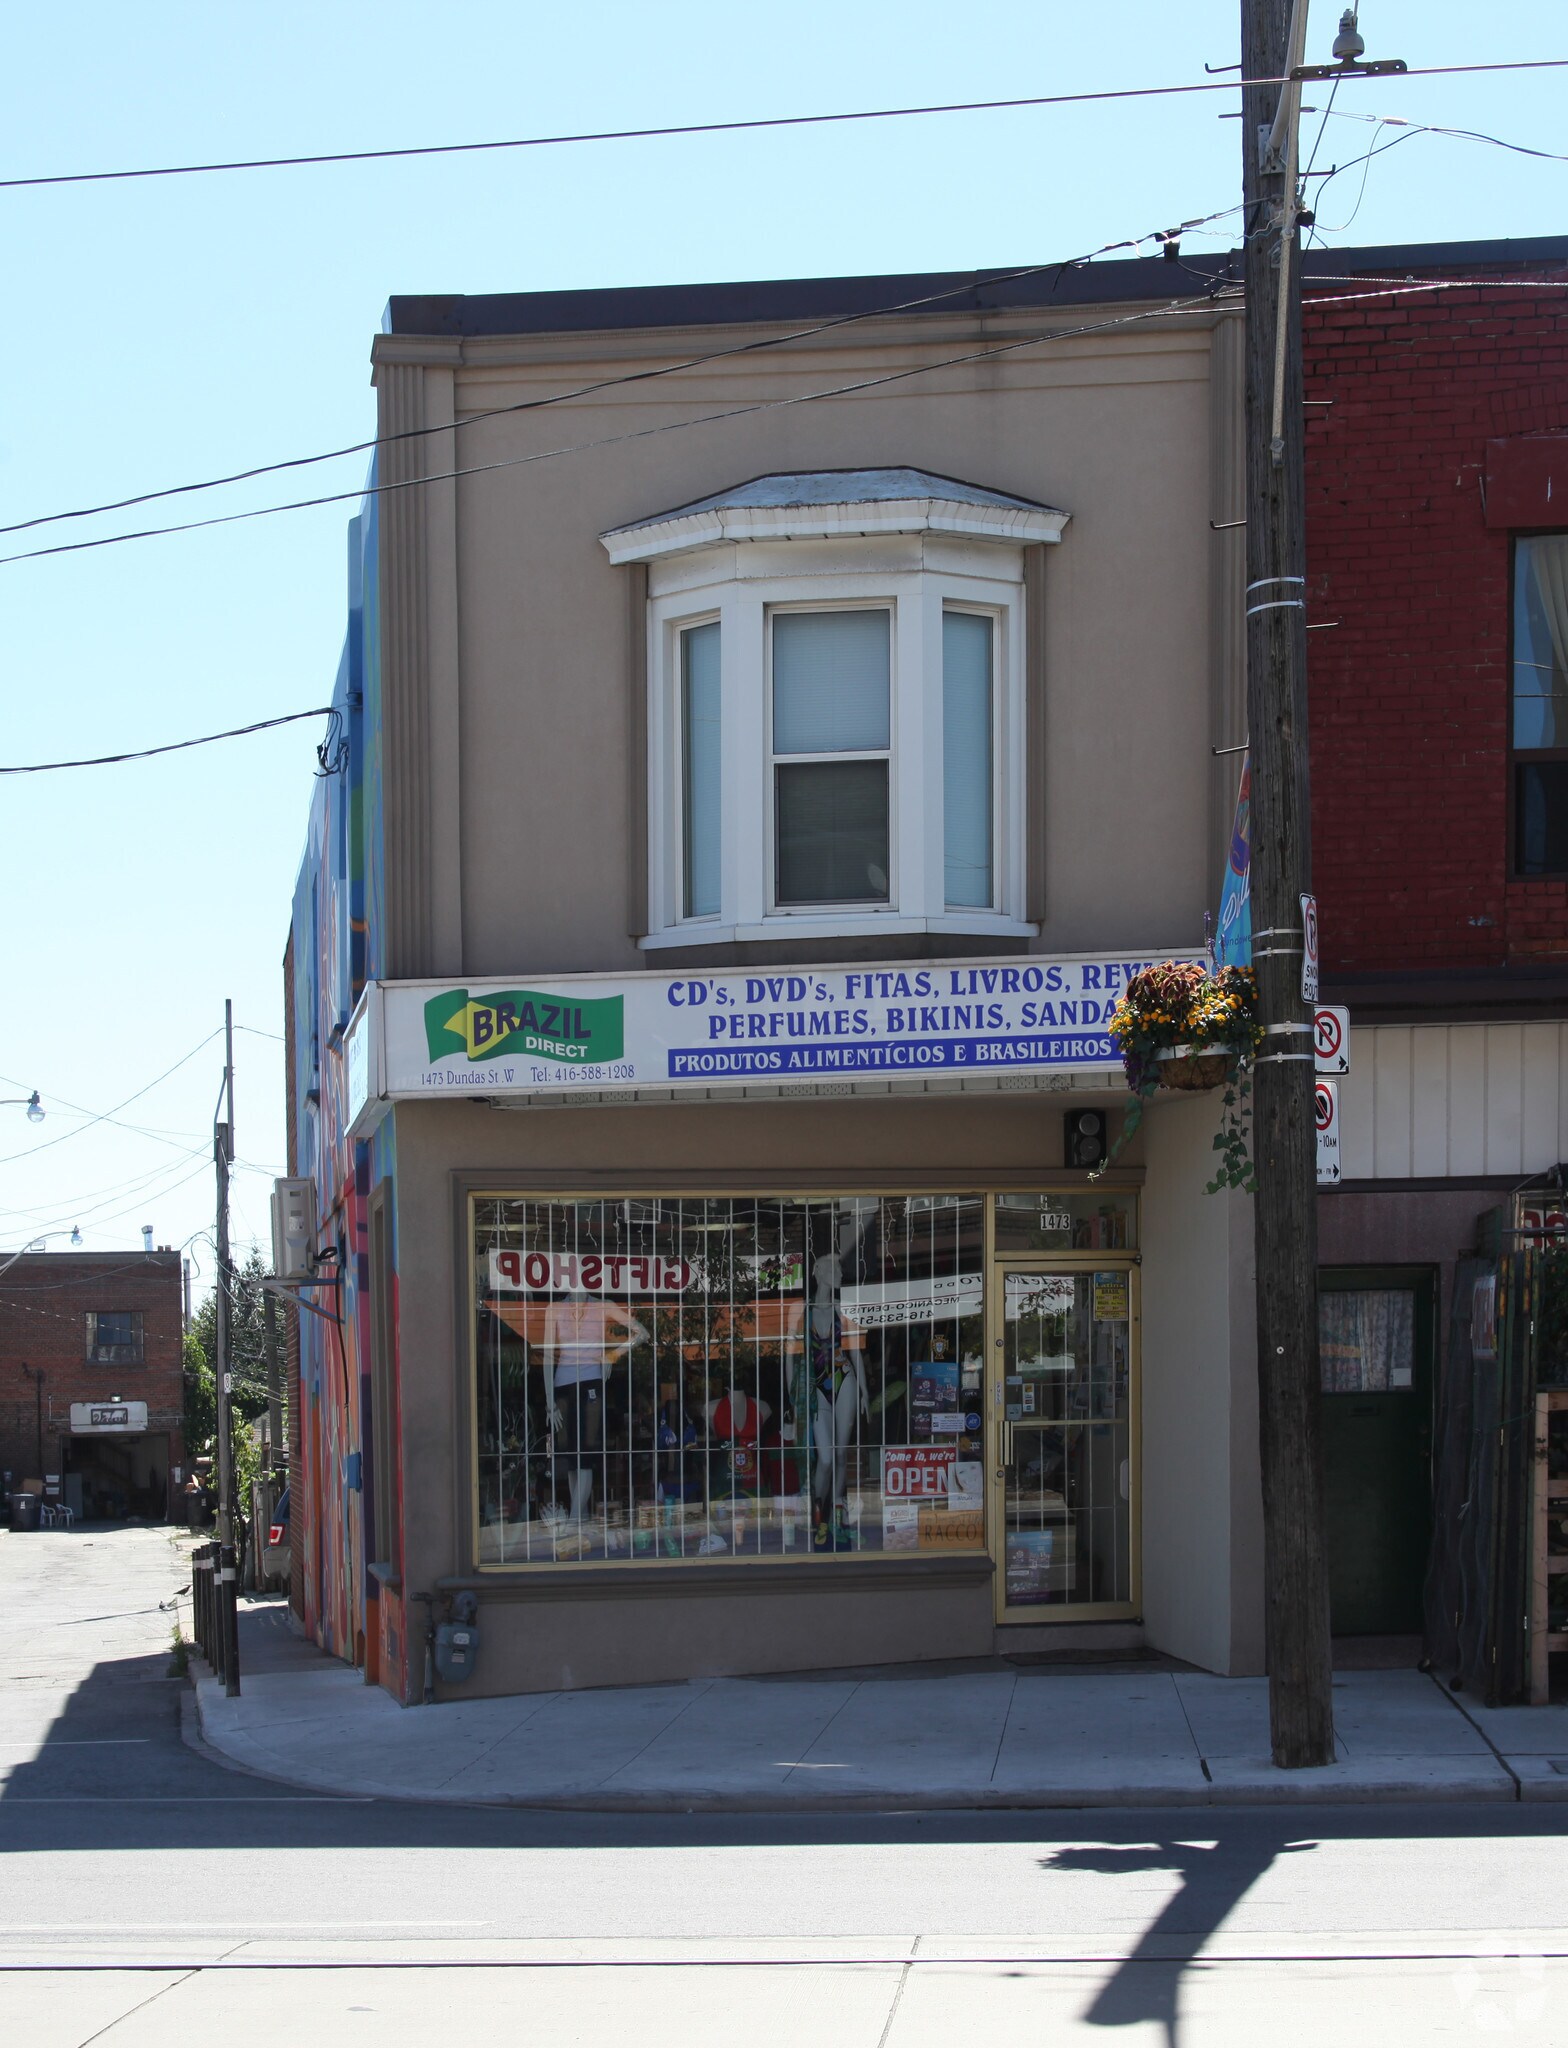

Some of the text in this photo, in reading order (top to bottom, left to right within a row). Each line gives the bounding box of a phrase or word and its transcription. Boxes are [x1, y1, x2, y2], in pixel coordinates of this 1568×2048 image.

[667, 979, 735, 1007] CD's,
[745, 975, 835, 1004] DVD's,
[845, 971, 940, 1000] FITAS,
[950, 965, 1071, 996] LIVROS,
[473, 1000, 592, 1047] BRAZIL
[708, 1008, 876, 1040] PERFUMES,
[886, 1003, 1011, 1034] BIKINIS,
[525, 1036, 588, 1058] DIRECT
[674, 1038, 1112, 1073] PRODUTOS ALIMENTÍCIOS E BRASILEIROS
[421, 1072, 444, 1086] 1473
[446, 1069, 486, 1085] Dundas
[530, 1066, 551, 1083] Tel:
[554, 1064, 635, 1082] 416-588-1208
[1041, 1214, 1070, 1229] 1473
[885, 1450, 956, 1462] Come in, we're
[886, 1466, 949, 1495] OPEN
